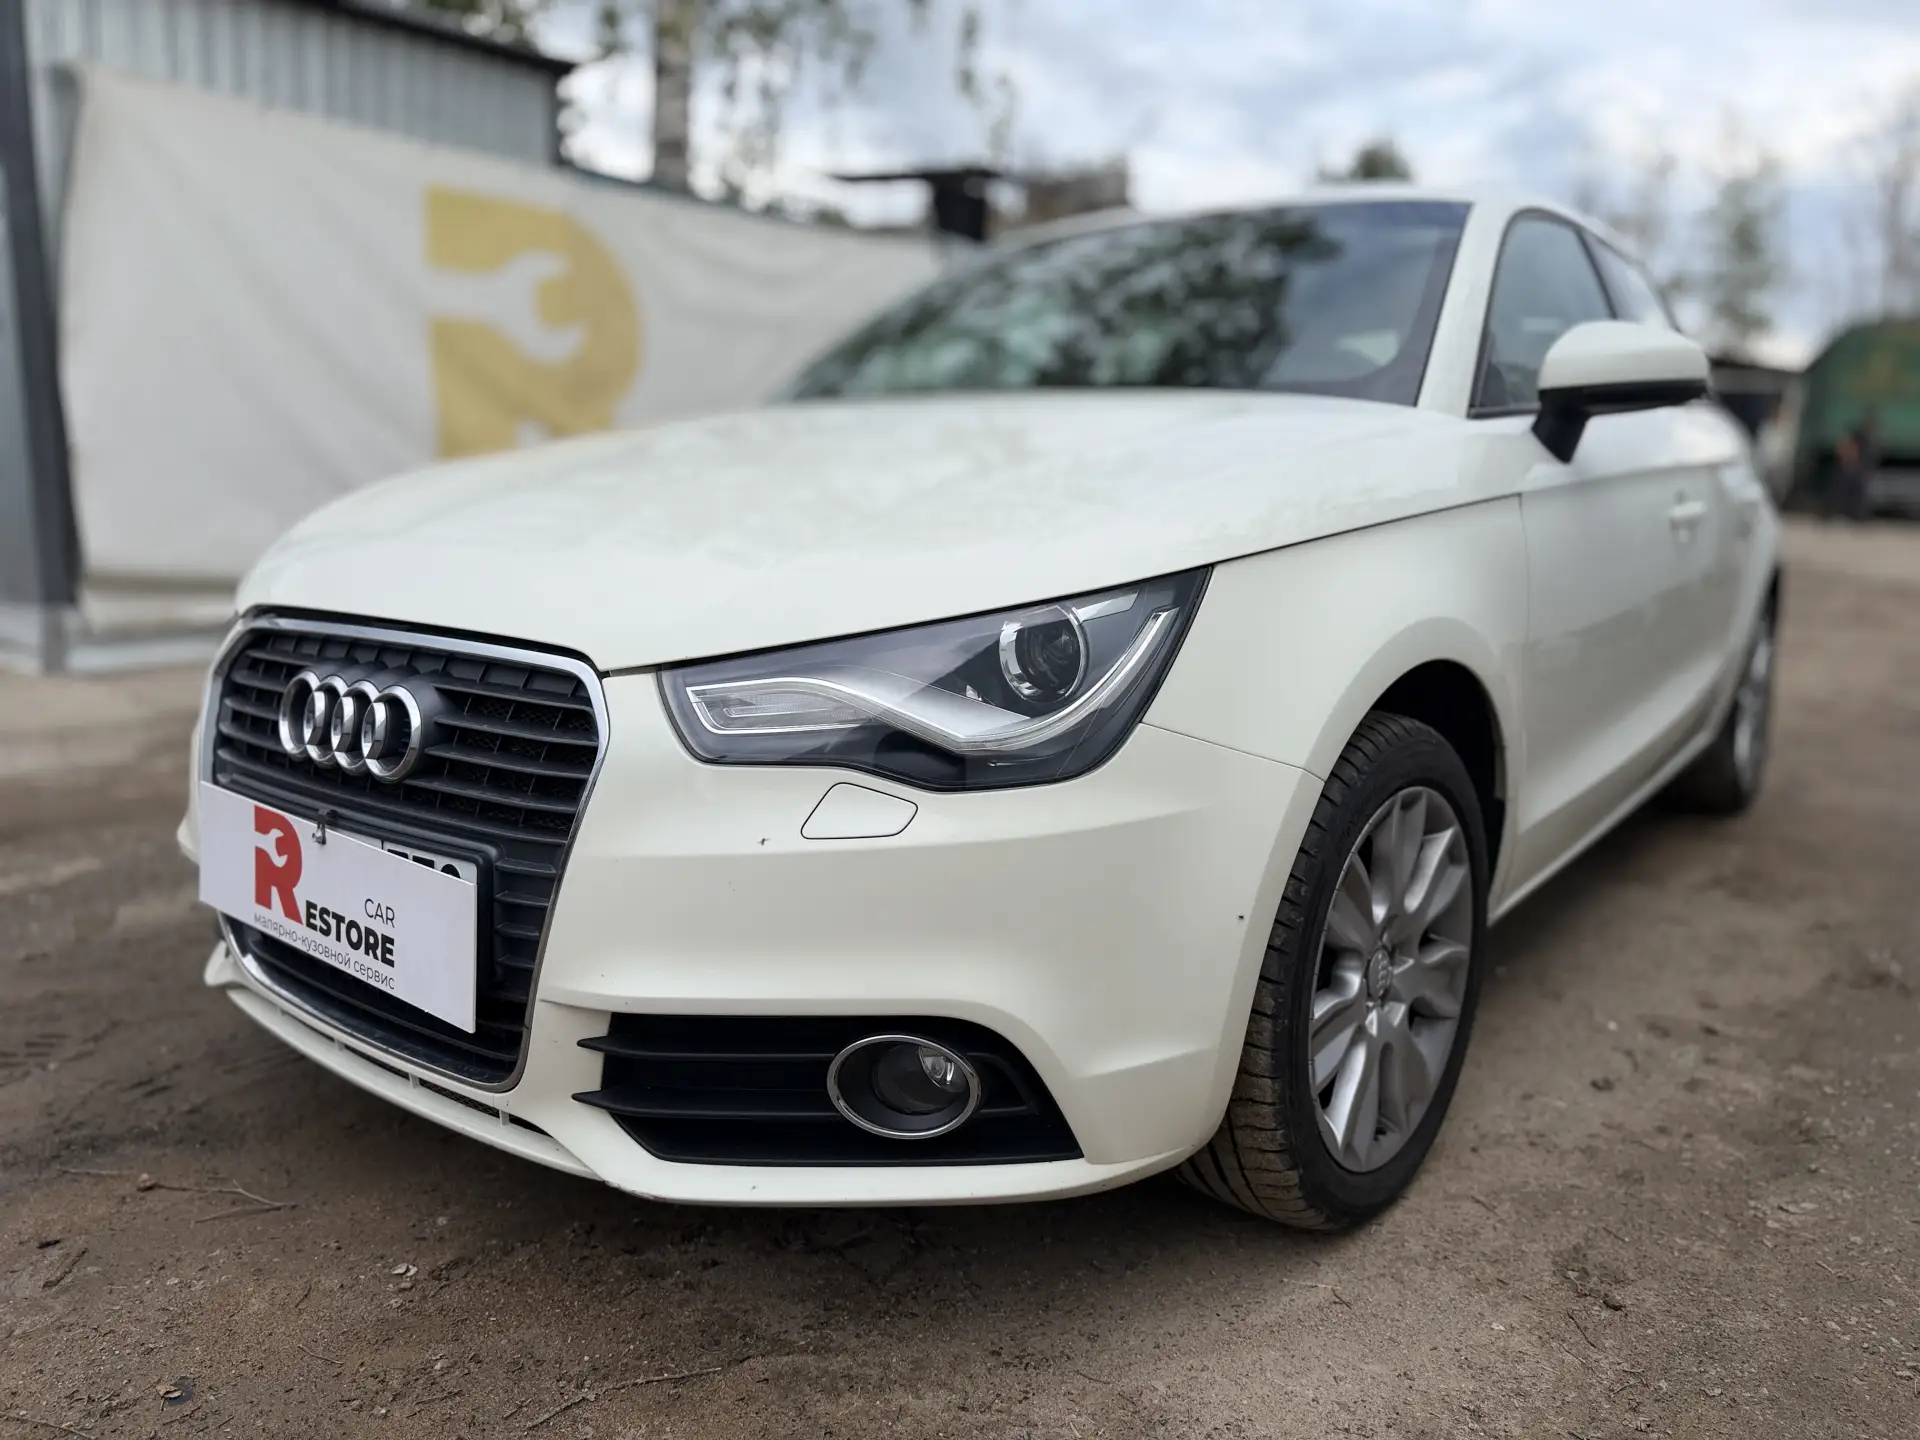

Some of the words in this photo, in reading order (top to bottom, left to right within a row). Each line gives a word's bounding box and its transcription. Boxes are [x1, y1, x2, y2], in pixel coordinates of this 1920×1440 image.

[364, 898, 395, 928] CAR
[254, 913, 351, 969] малярно-кузовной
[353, 961, 395, 990] сервис
